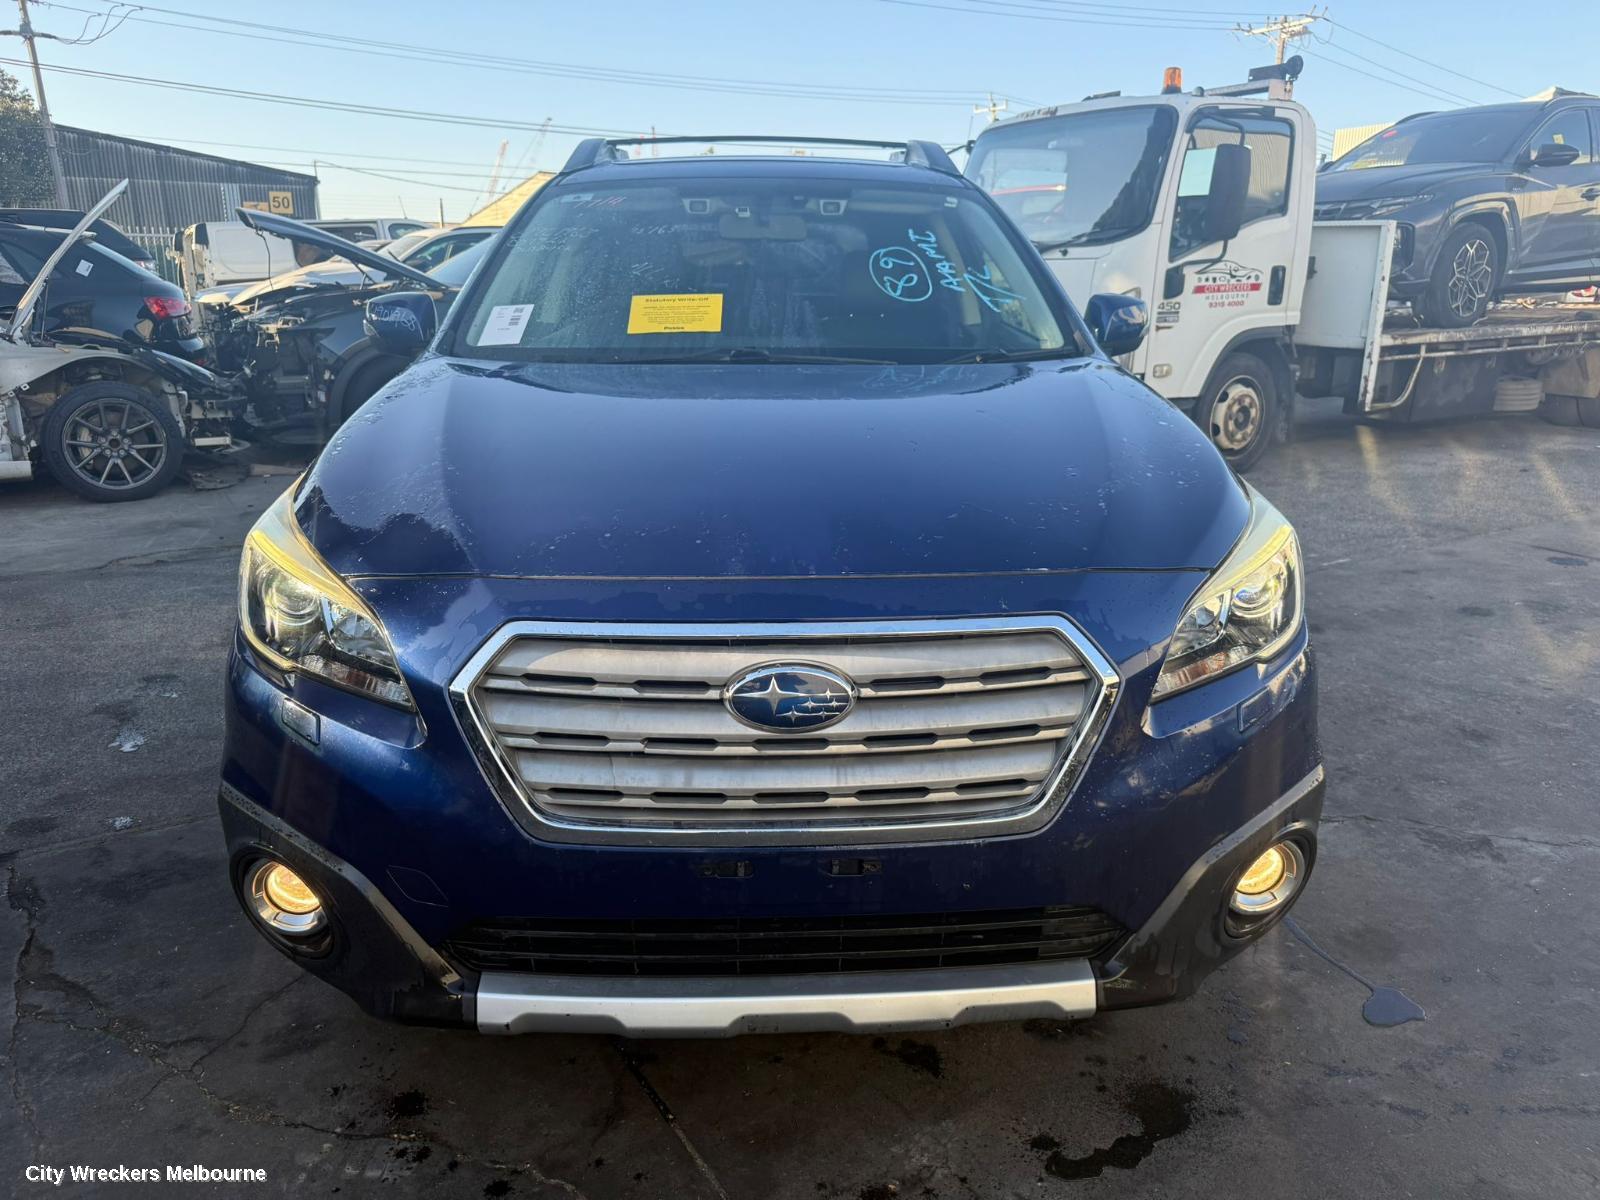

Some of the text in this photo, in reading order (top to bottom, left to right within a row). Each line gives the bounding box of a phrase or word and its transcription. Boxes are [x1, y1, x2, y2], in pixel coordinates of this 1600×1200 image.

[272, 196, 290, 209] 50
[1204, 283, 1251, 293] CITY WRECKERS
[1157, 301, 1181, 311] 450
